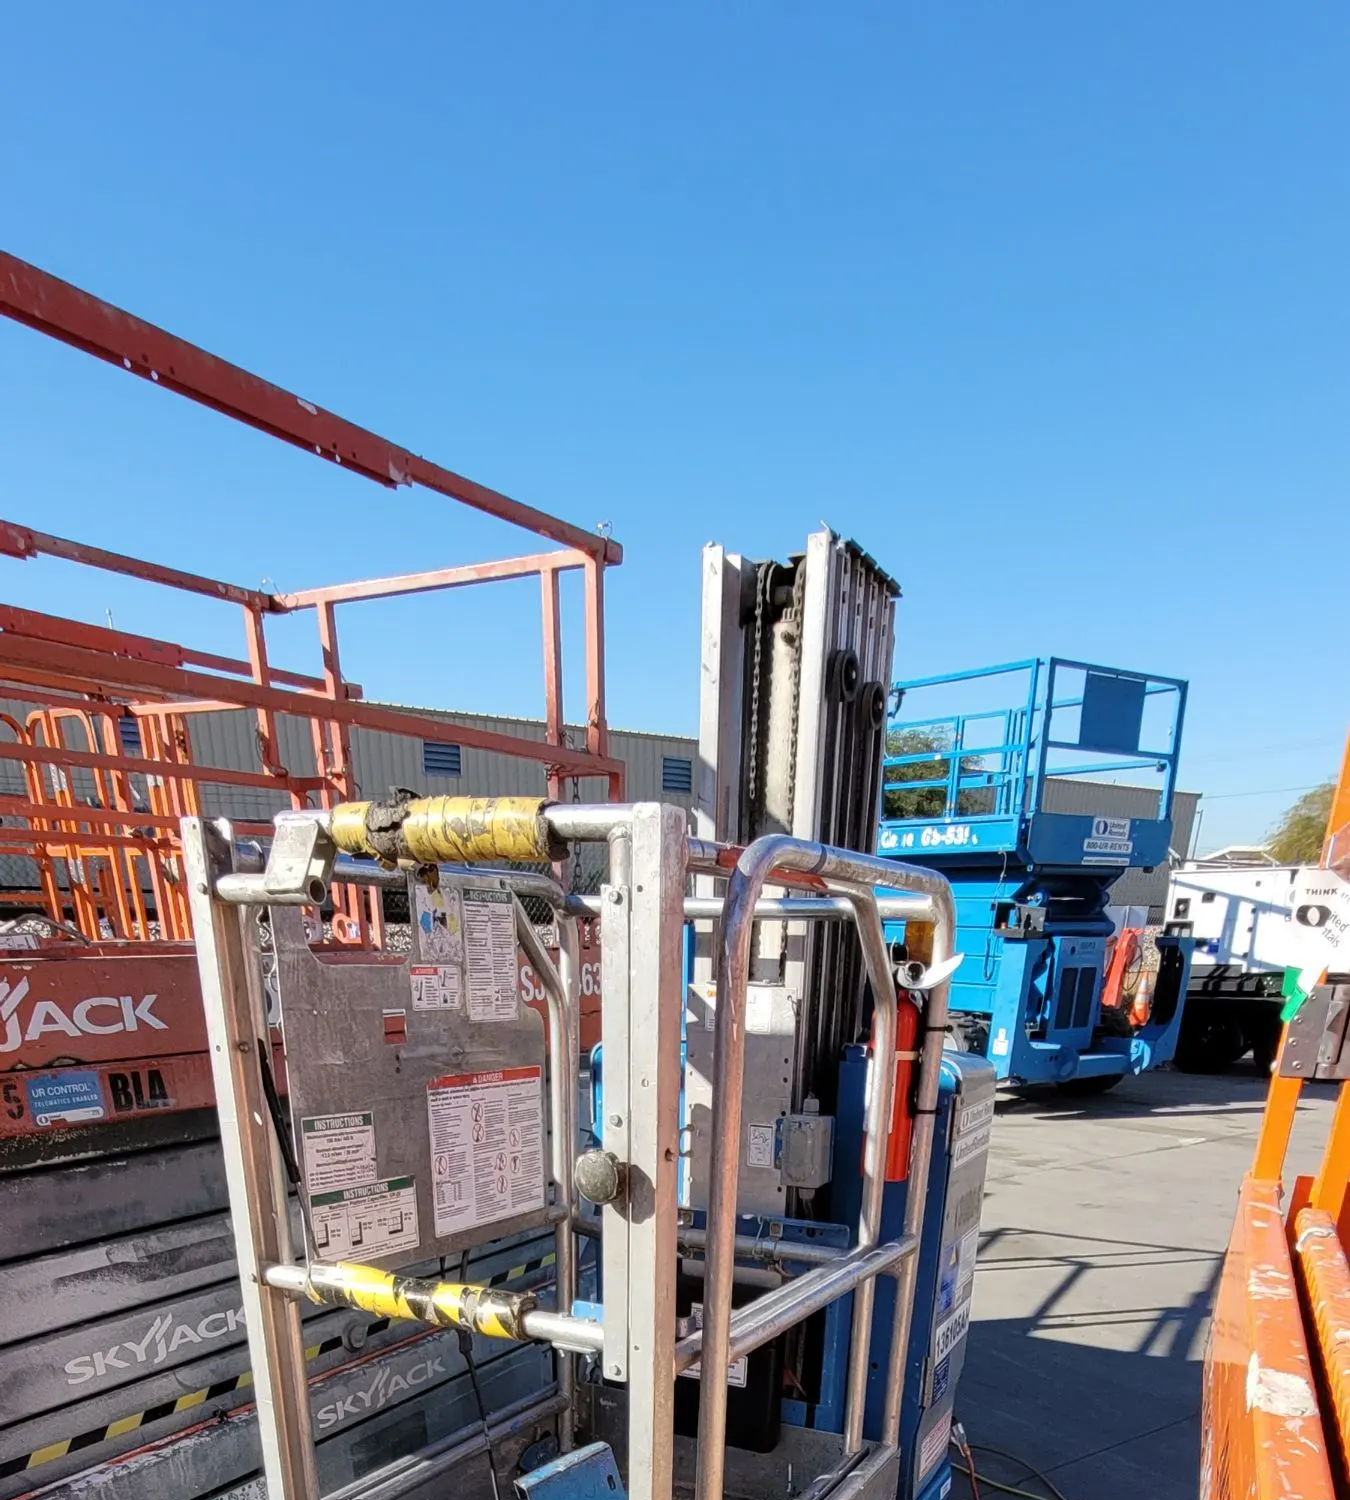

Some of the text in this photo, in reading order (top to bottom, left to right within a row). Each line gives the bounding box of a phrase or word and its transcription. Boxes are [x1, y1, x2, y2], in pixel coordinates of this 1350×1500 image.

[1305, 888, 1338, 896] THINK
[1328, 911, 1350, 933] ited
[0, 976, 169, 1052] JACK
[31, 1083, 91, 1098] UR CONTROL
[34, 1094, 98, 1108] TELEMATICS ENABLED
[314, 1116, 364, 1130] INSTRUCTIONS
[343, 1183, 389, 1200] INSTRUCTIONS
[64, 1311, 247, 1385] SKYJACK
[317, 1357, 446, 1429] SKYJACK
